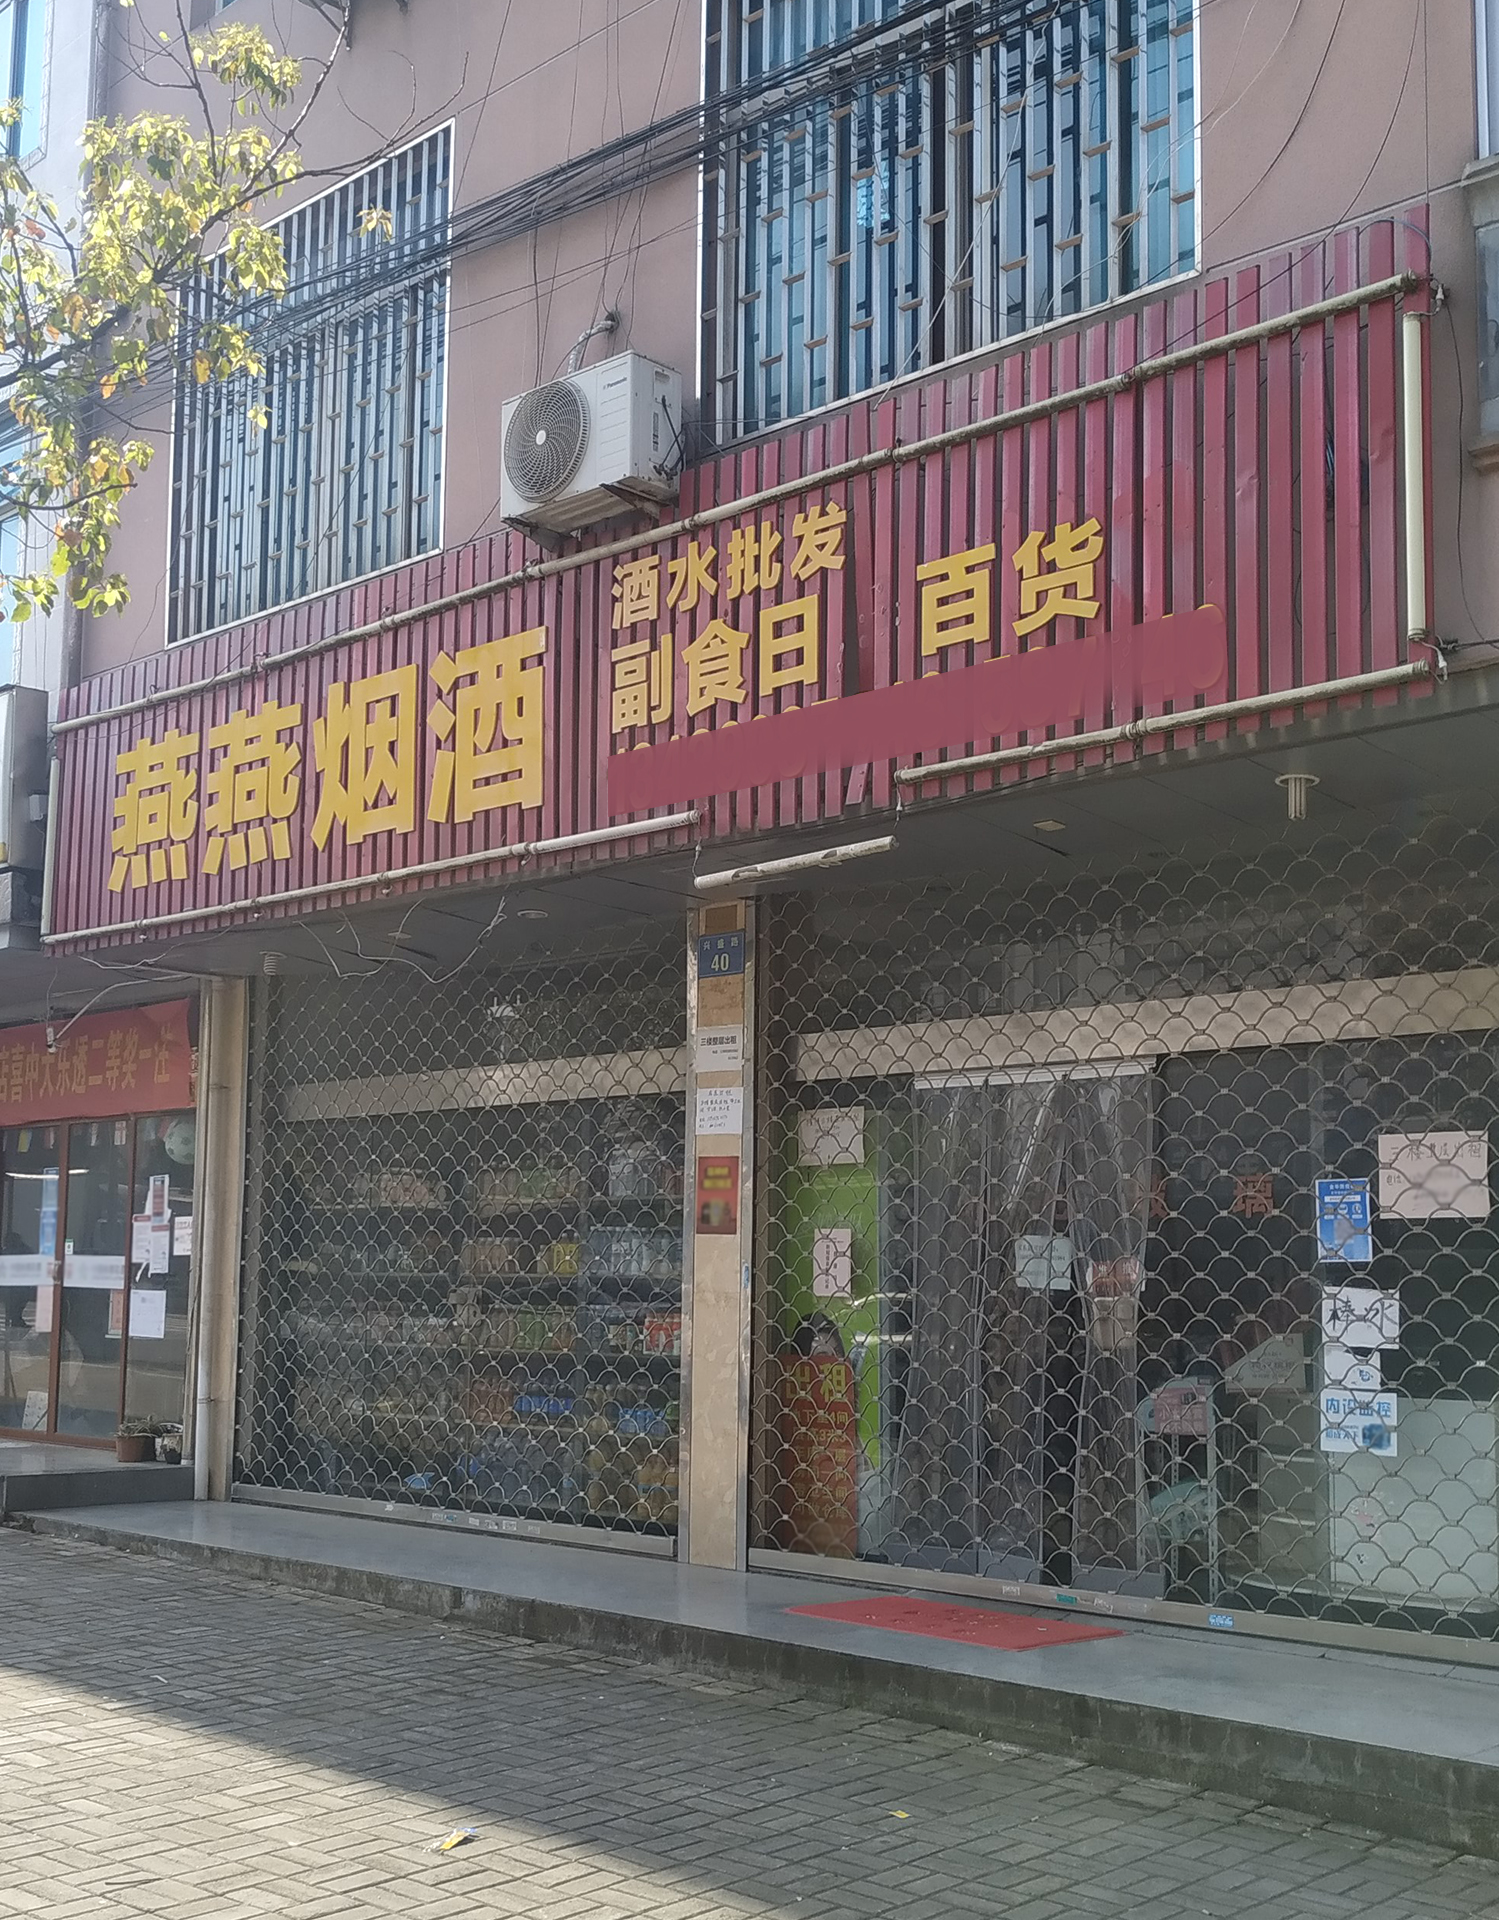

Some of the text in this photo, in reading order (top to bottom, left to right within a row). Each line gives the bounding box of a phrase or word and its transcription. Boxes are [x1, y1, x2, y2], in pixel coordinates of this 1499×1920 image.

[611, 500, 848, 630] 酒水批发
[916, 517, 1104, 657] 百货
[107, 625, 549, 893] 燕燕烟酒
[711, 953, 729, 971] 40
[785, 1362, 848, 1403] 出租
